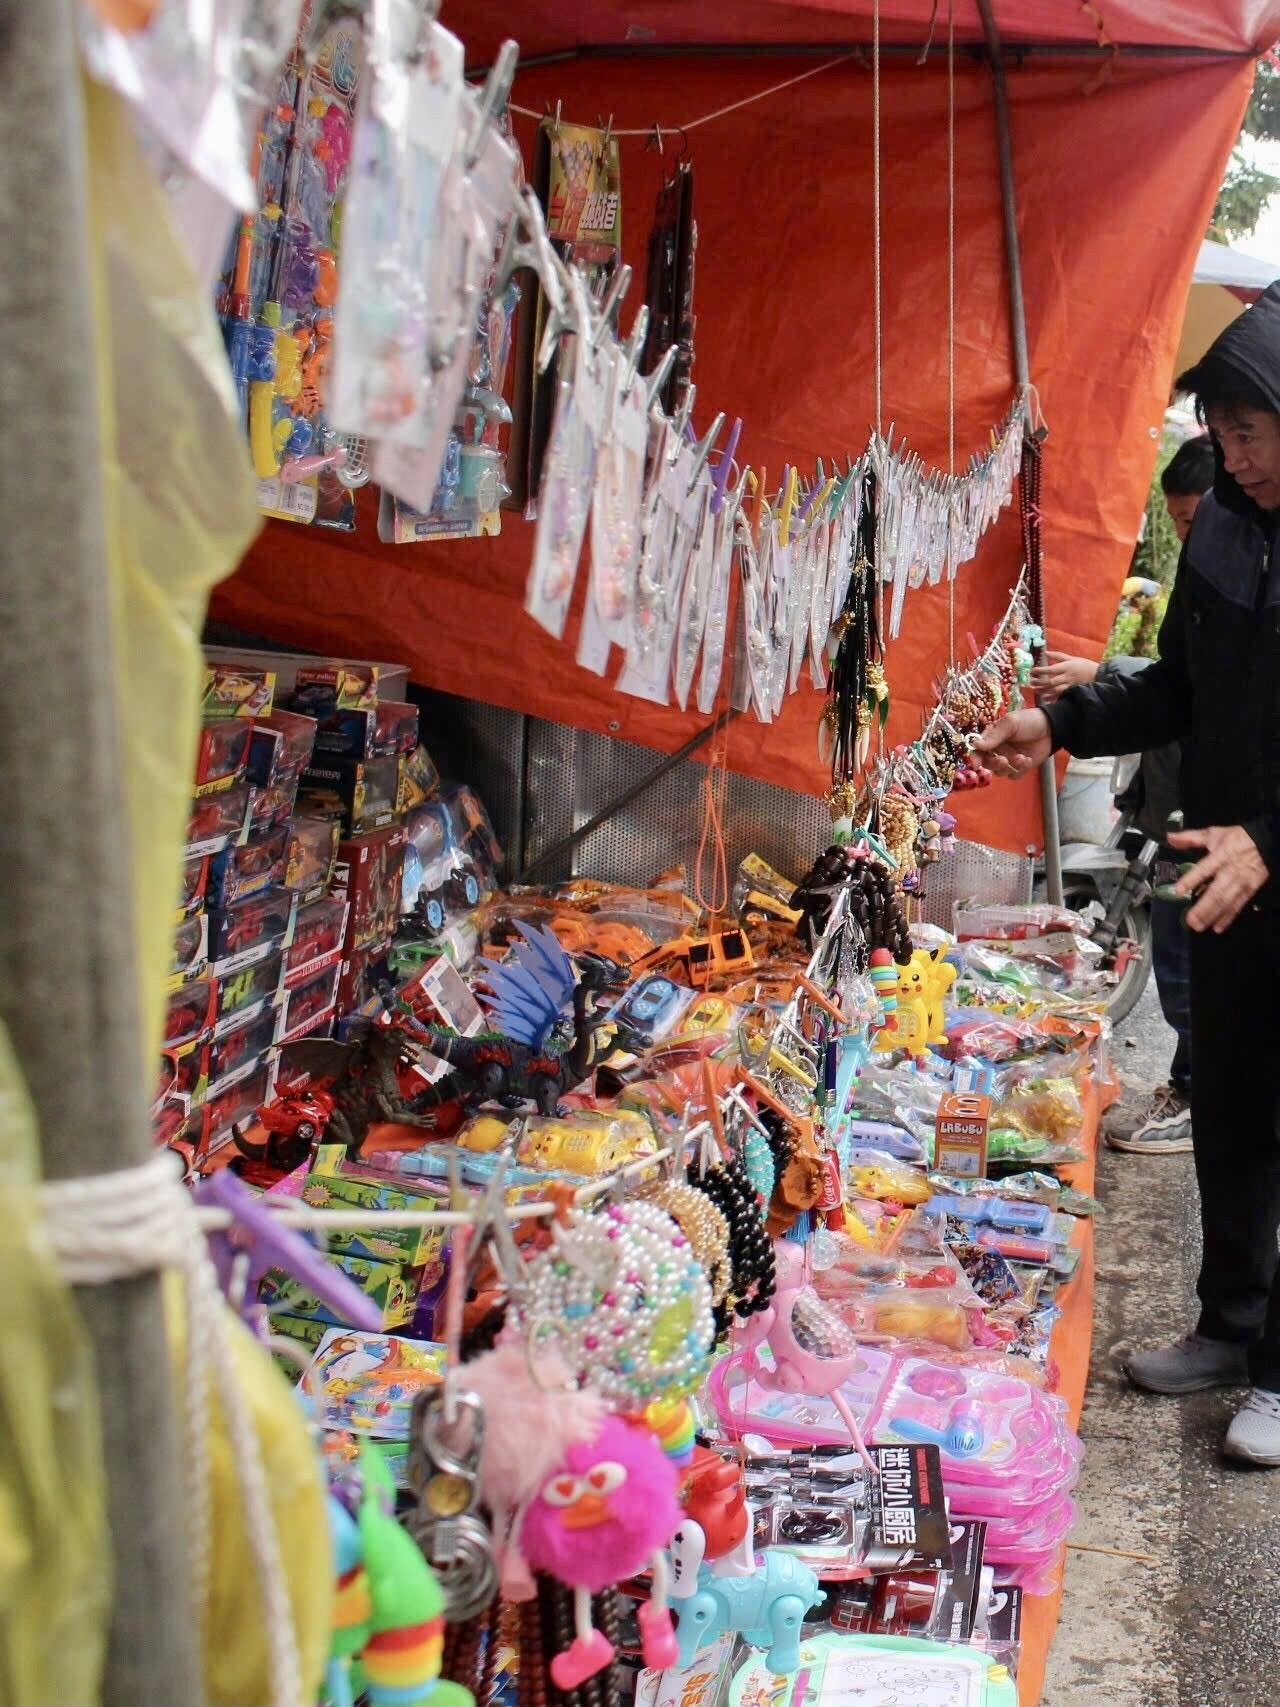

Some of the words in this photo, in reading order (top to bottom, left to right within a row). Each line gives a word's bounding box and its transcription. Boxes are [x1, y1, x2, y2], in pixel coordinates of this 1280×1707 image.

[881, 1447, 917, 1545] 迷你小厨房
